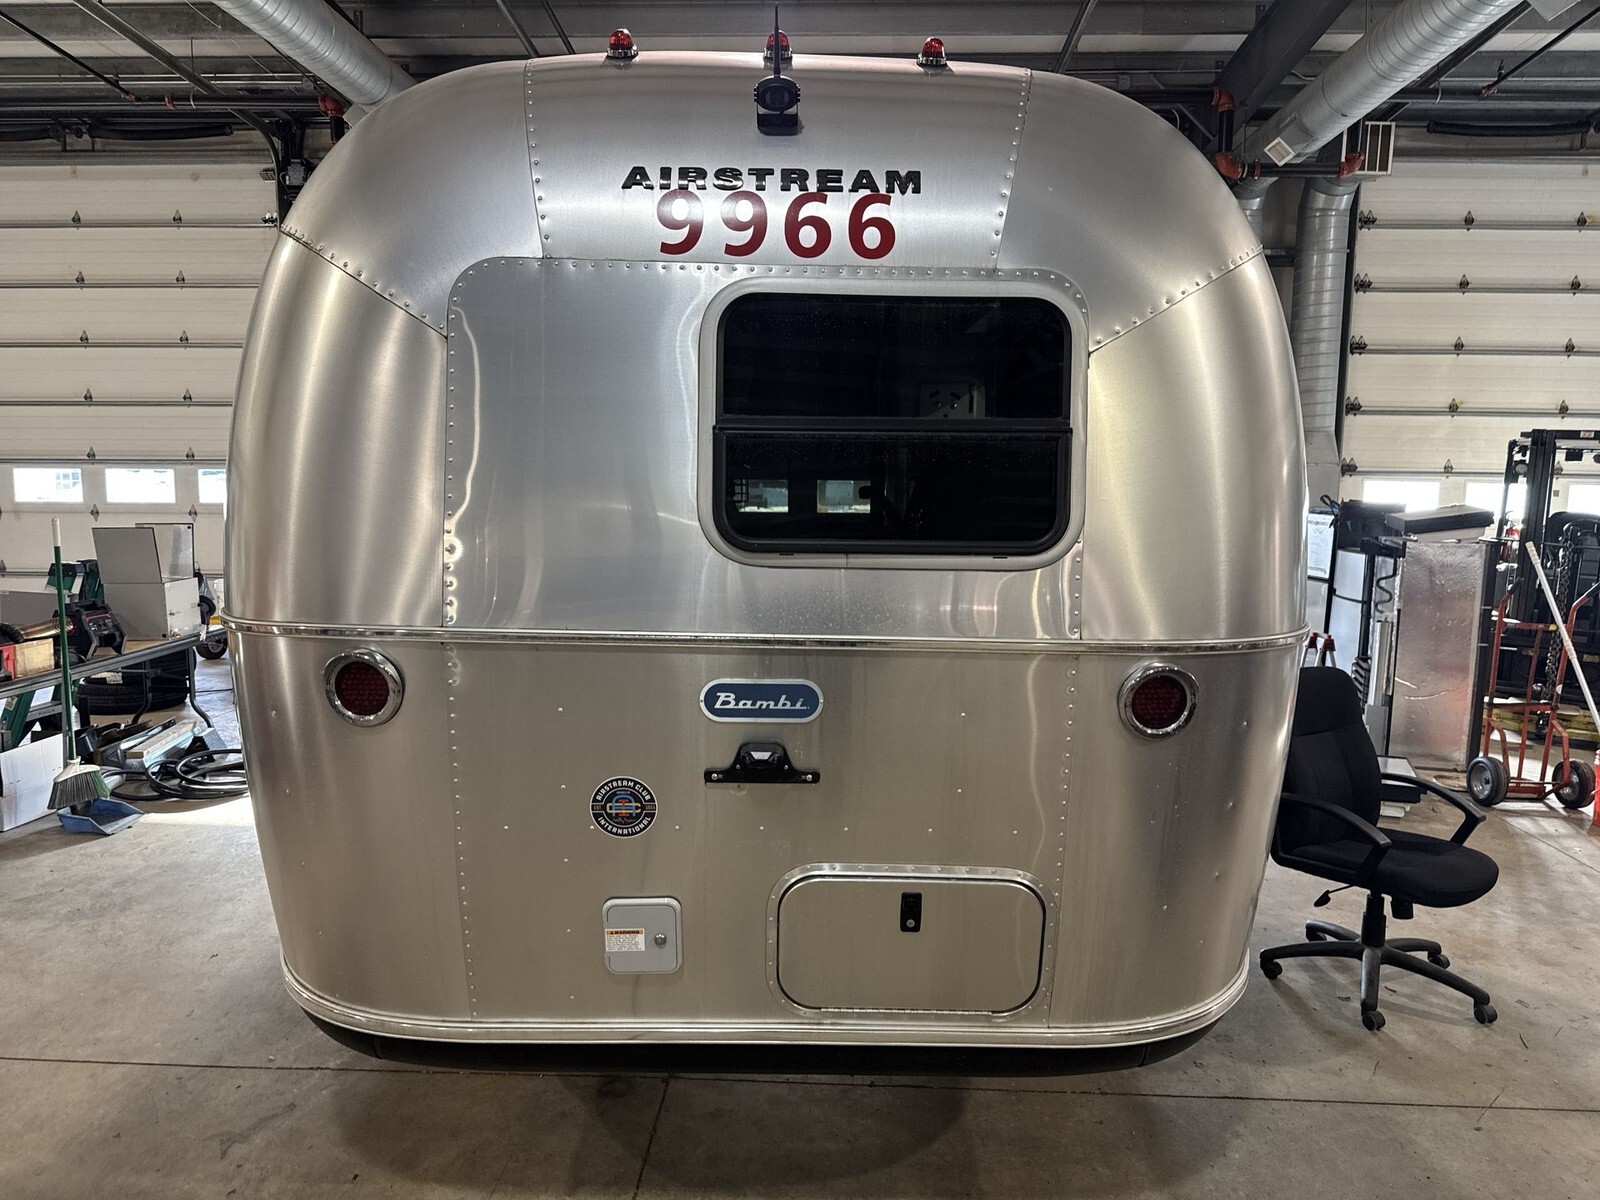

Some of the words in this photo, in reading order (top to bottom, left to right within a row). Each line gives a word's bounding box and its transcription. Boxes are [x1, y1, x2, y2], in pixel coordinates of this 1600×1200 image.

[621, 165, 922, 195] AIRSTREAM
[656, 188, 896, 260] 9966
[713, 692, 807, 710] Bambi
[596, 780, 634, 801] AIRSTREAM
[635, 784, 651, 801] CLUB
[598, 816, 652, 835] INTERNATIONAL
